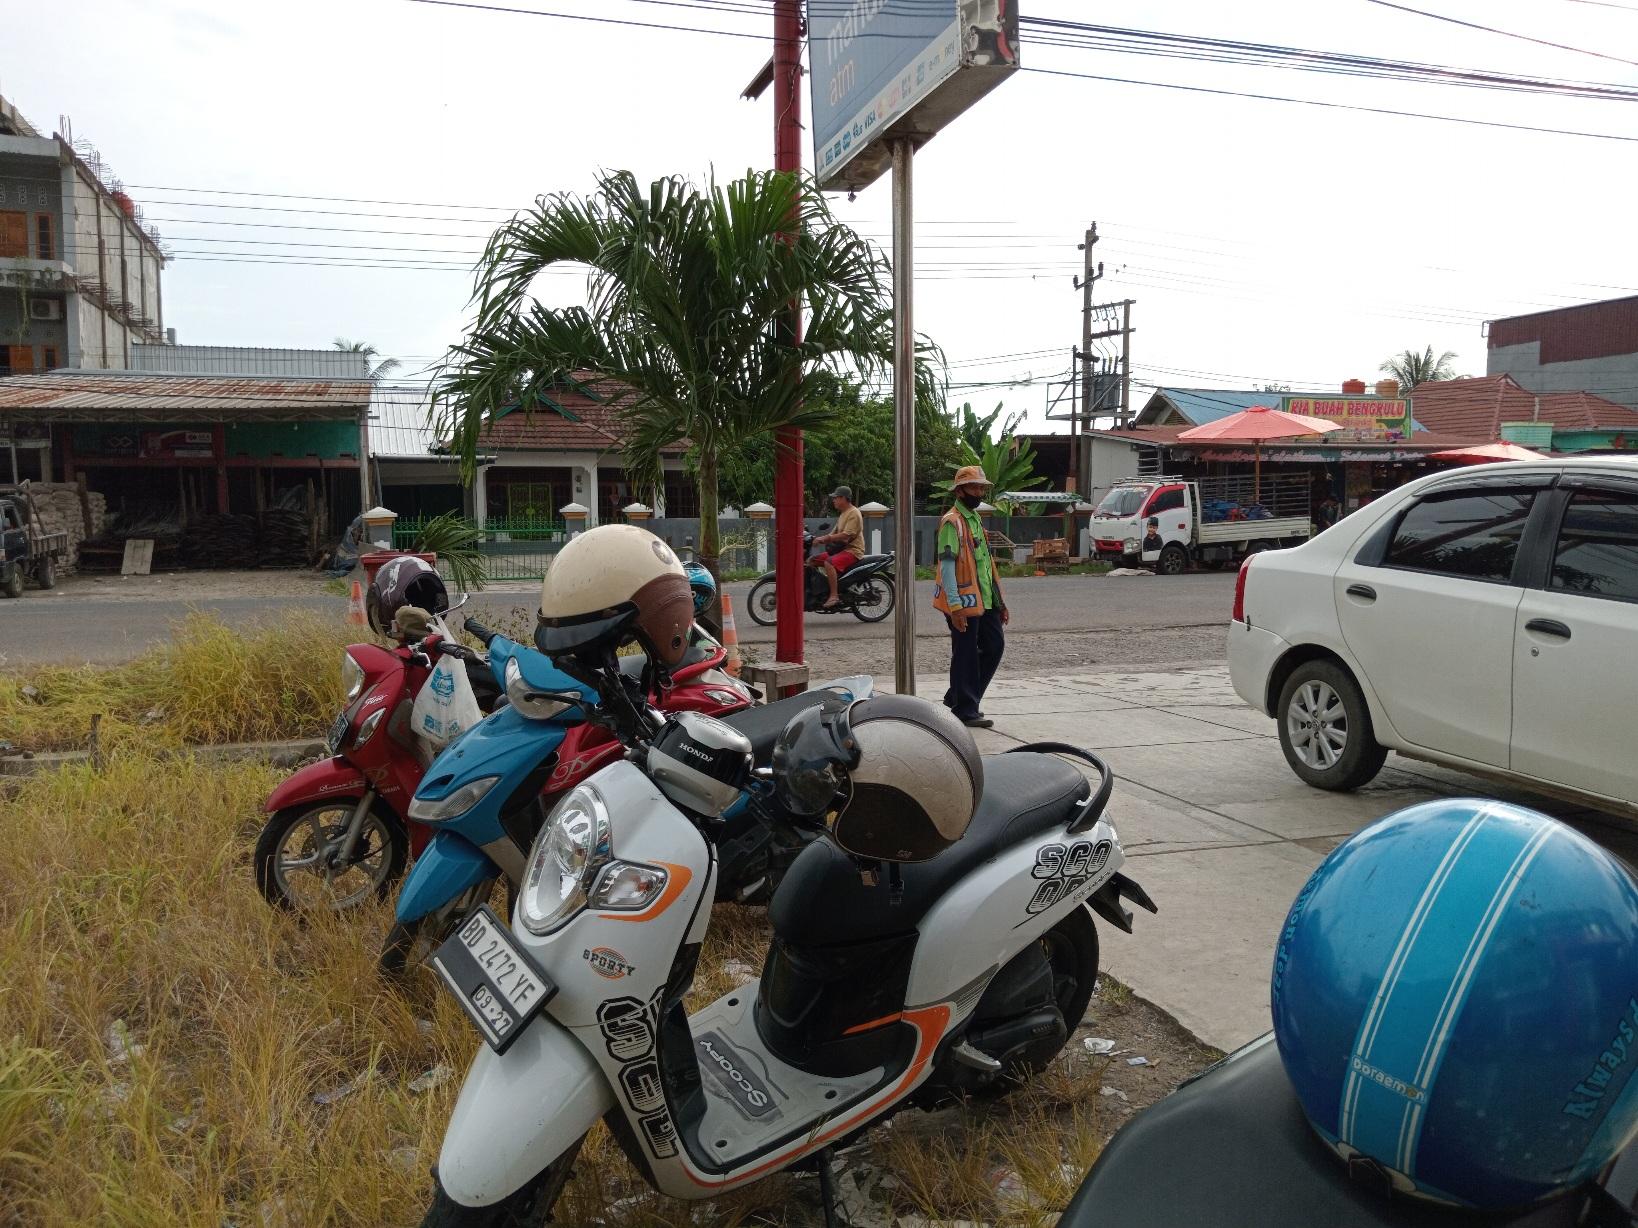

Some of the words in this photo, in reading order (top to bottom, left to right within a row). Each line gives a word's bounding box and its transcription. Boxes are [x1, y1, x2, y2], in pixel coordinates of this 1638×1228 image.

[830, 58, 855, 106] atm
[863, 109, 876, 129] VISA
[1313, 400, 1345, 417] BUAH
[1347, 400, 1405, 417] BENGKULU
[461, 918, 487, 948] BD
[478, 940, 517, 985] 2472
[509, 973, 536, 1004] YF
[582, 948, 636, 976] SPORTY
[1352, 1055, 1426, 1101] Doraemon
[1561, 1018, 1635, 1121] Always
